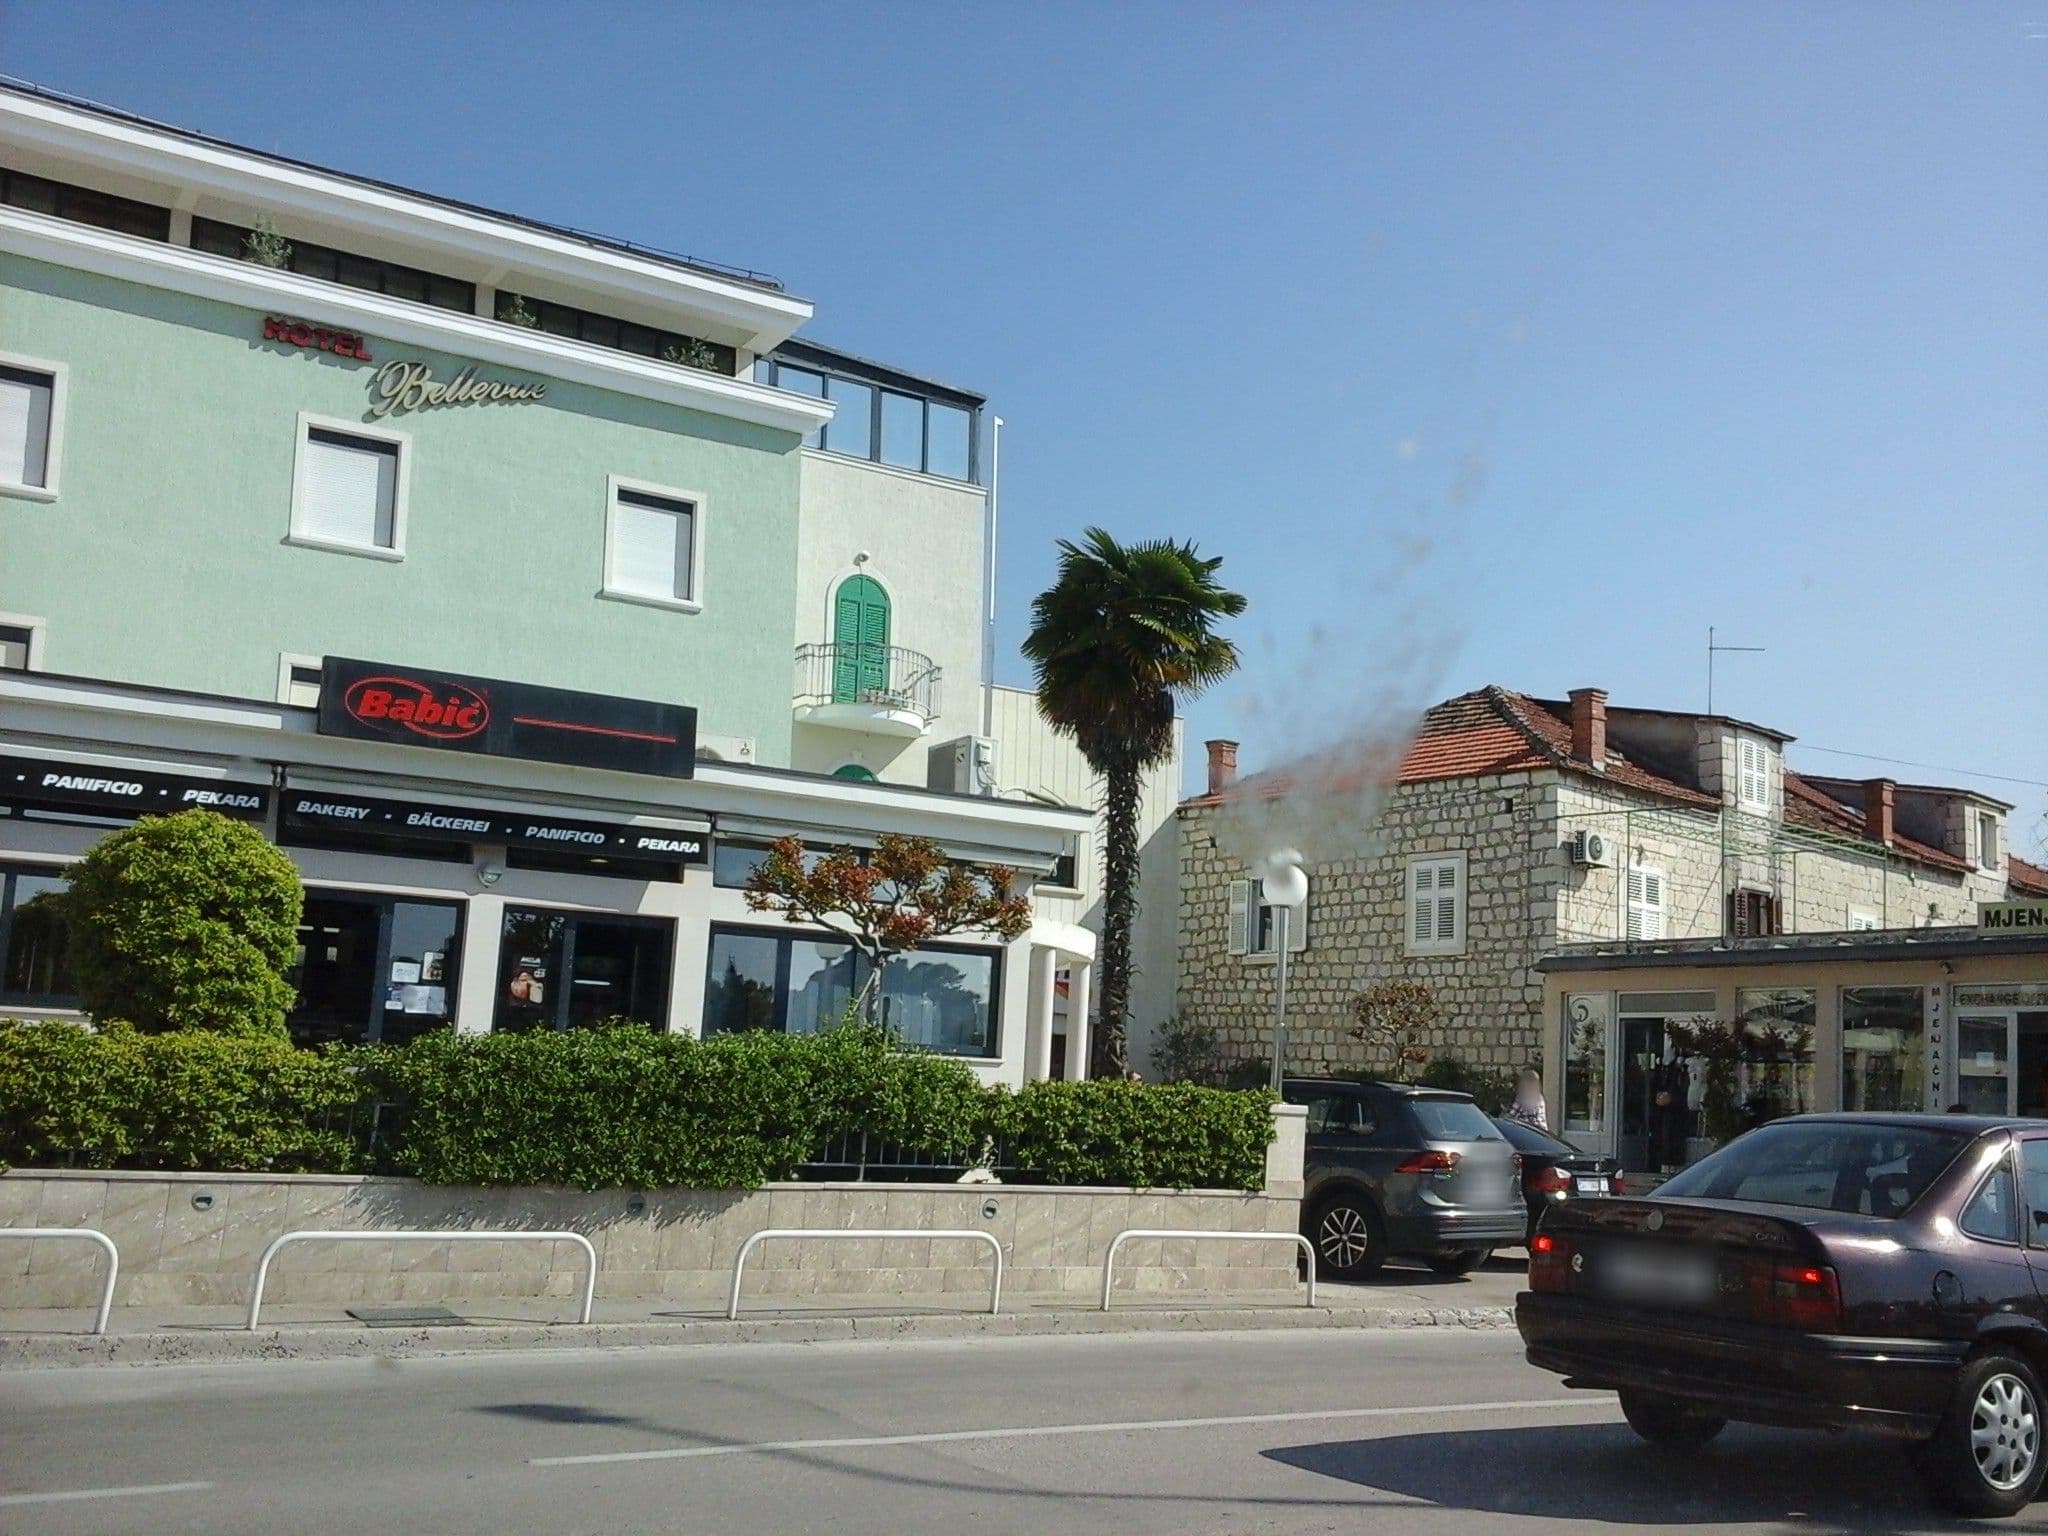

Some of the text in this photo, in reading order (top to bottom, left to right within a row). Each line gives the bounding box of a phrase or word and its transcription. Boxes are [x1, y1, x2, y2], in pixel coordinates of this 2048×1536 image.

[263, 316, 372, 361] HOTEL
[369, 360, 547, 417] Bellevue
[356, 689, 481, 728] Babić
[42, 773, 260, 809] PANIFICIO PEKARA
[296, 800, 700, 854] BAKERY BÄCKEREI PANIFICIO PEKARA
